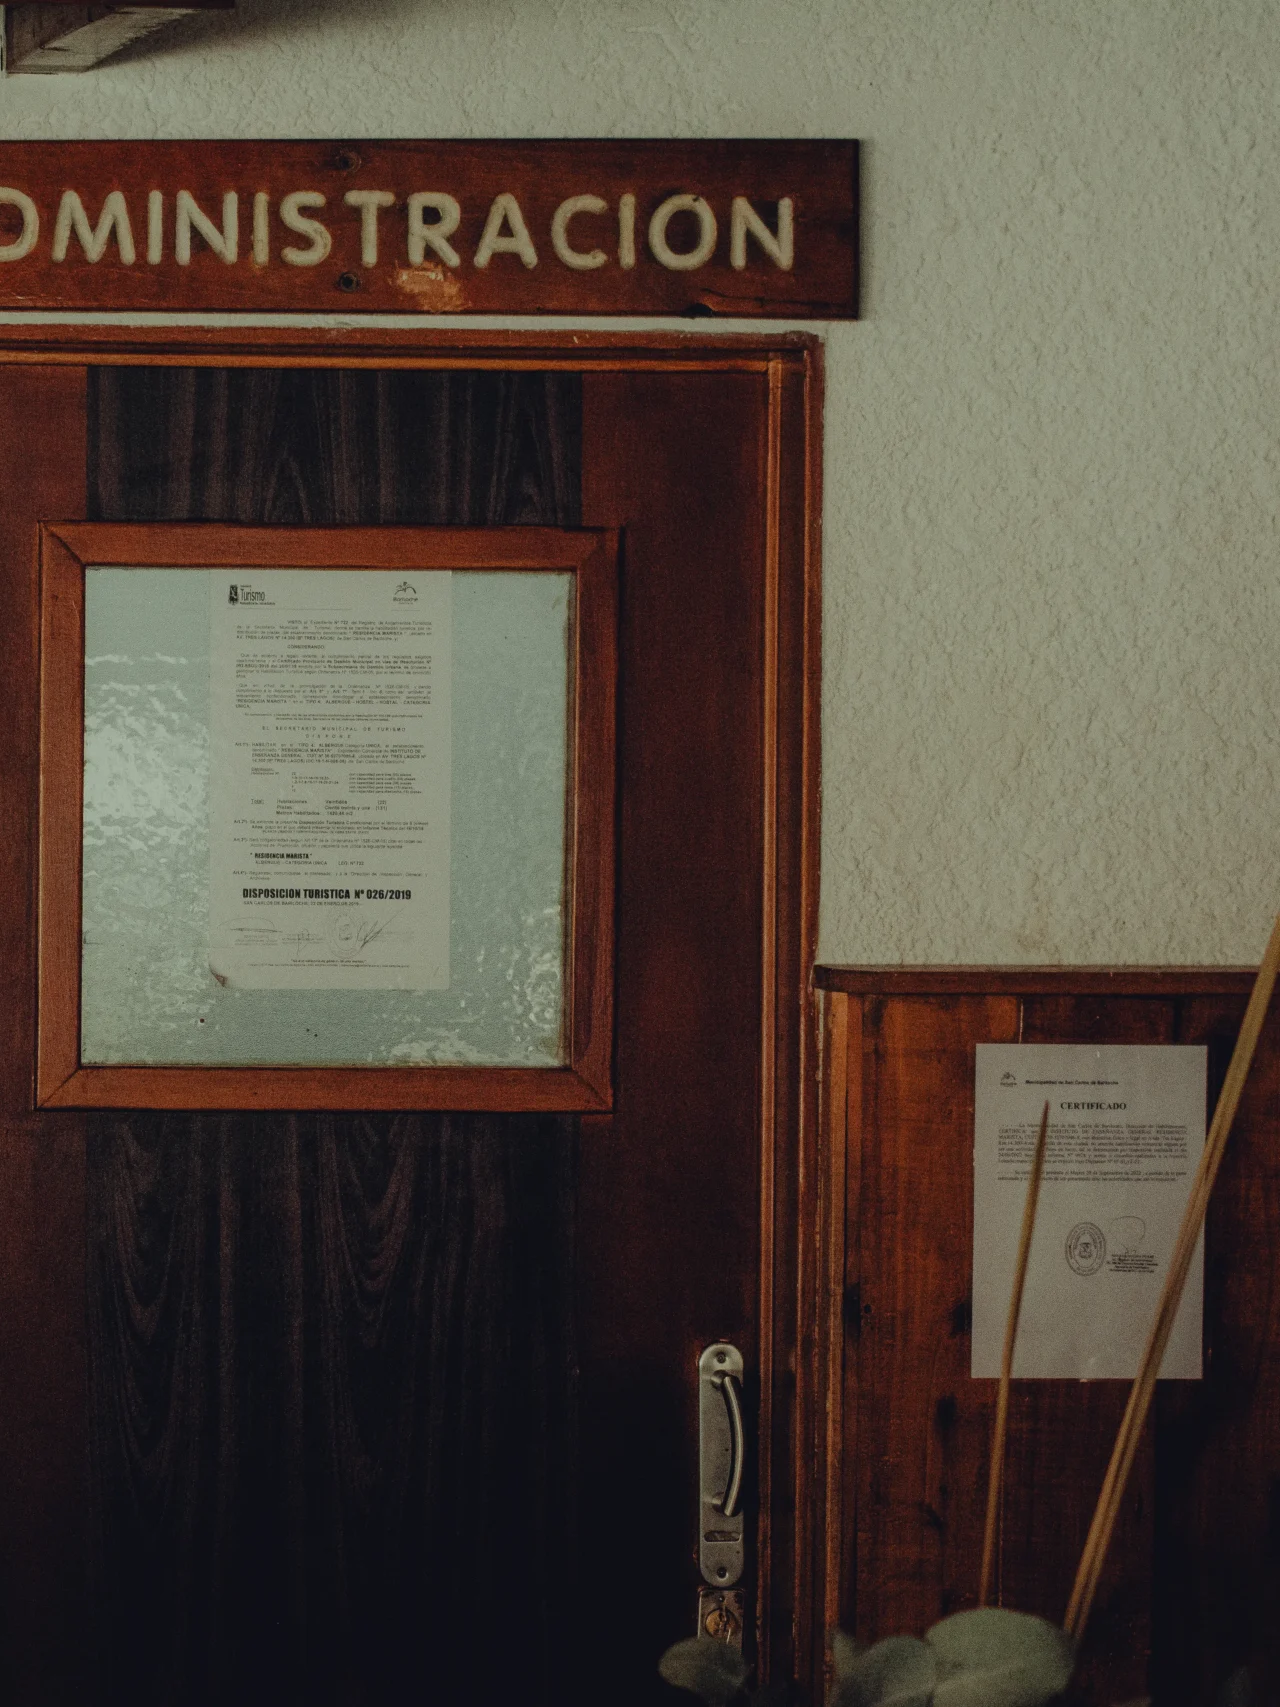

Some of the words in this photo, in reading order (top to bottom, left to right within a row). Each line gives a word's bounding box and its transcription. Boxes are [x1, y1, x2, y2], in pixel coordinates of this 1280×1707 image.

[240, 588, 266, 602] Turismo
[242, 888, 301, 900] DISPOSICION
[302, 888, 351, 900] TURISTICA
[366, 889, 412, 900] 026/2019
[1059, 1101, 1127, 1111] CERTIFICADO
